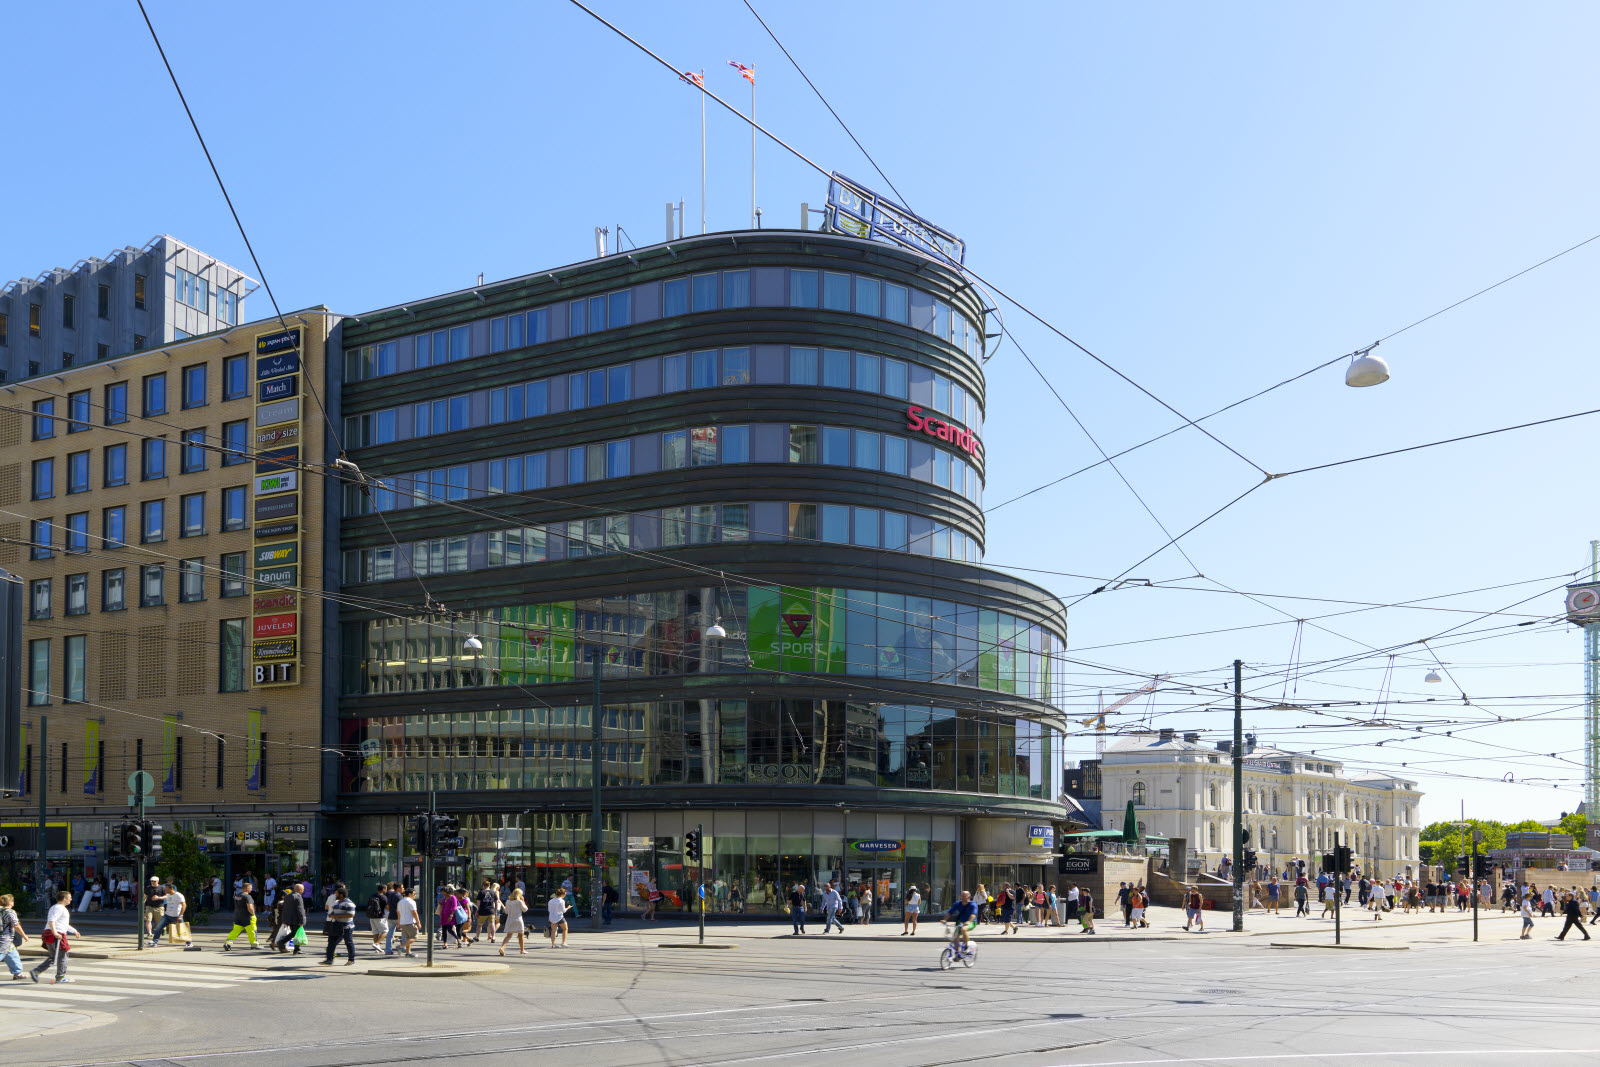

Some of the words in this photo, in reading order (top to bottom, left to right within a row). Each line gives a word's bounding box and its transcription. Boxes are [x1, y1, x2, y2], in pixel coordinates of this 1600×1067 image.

[266, 382, 287, 395] Match
[907, 405, 980, 459] Scandic
[261, 477, 280, 490] KIWI
[259, 548, 292, 561] SUBWAY
[260, 571, 291, 582] tanum
[254, 594, 295, 609] Scandic
[256, 621, 293, 632] JUVELEN
[770, 642, 824, 654] SPORT
[255, 663, 292, 683] BIT
[750, 764, 811, 779] EGON
[1033, 828, 1043, 836] BY
